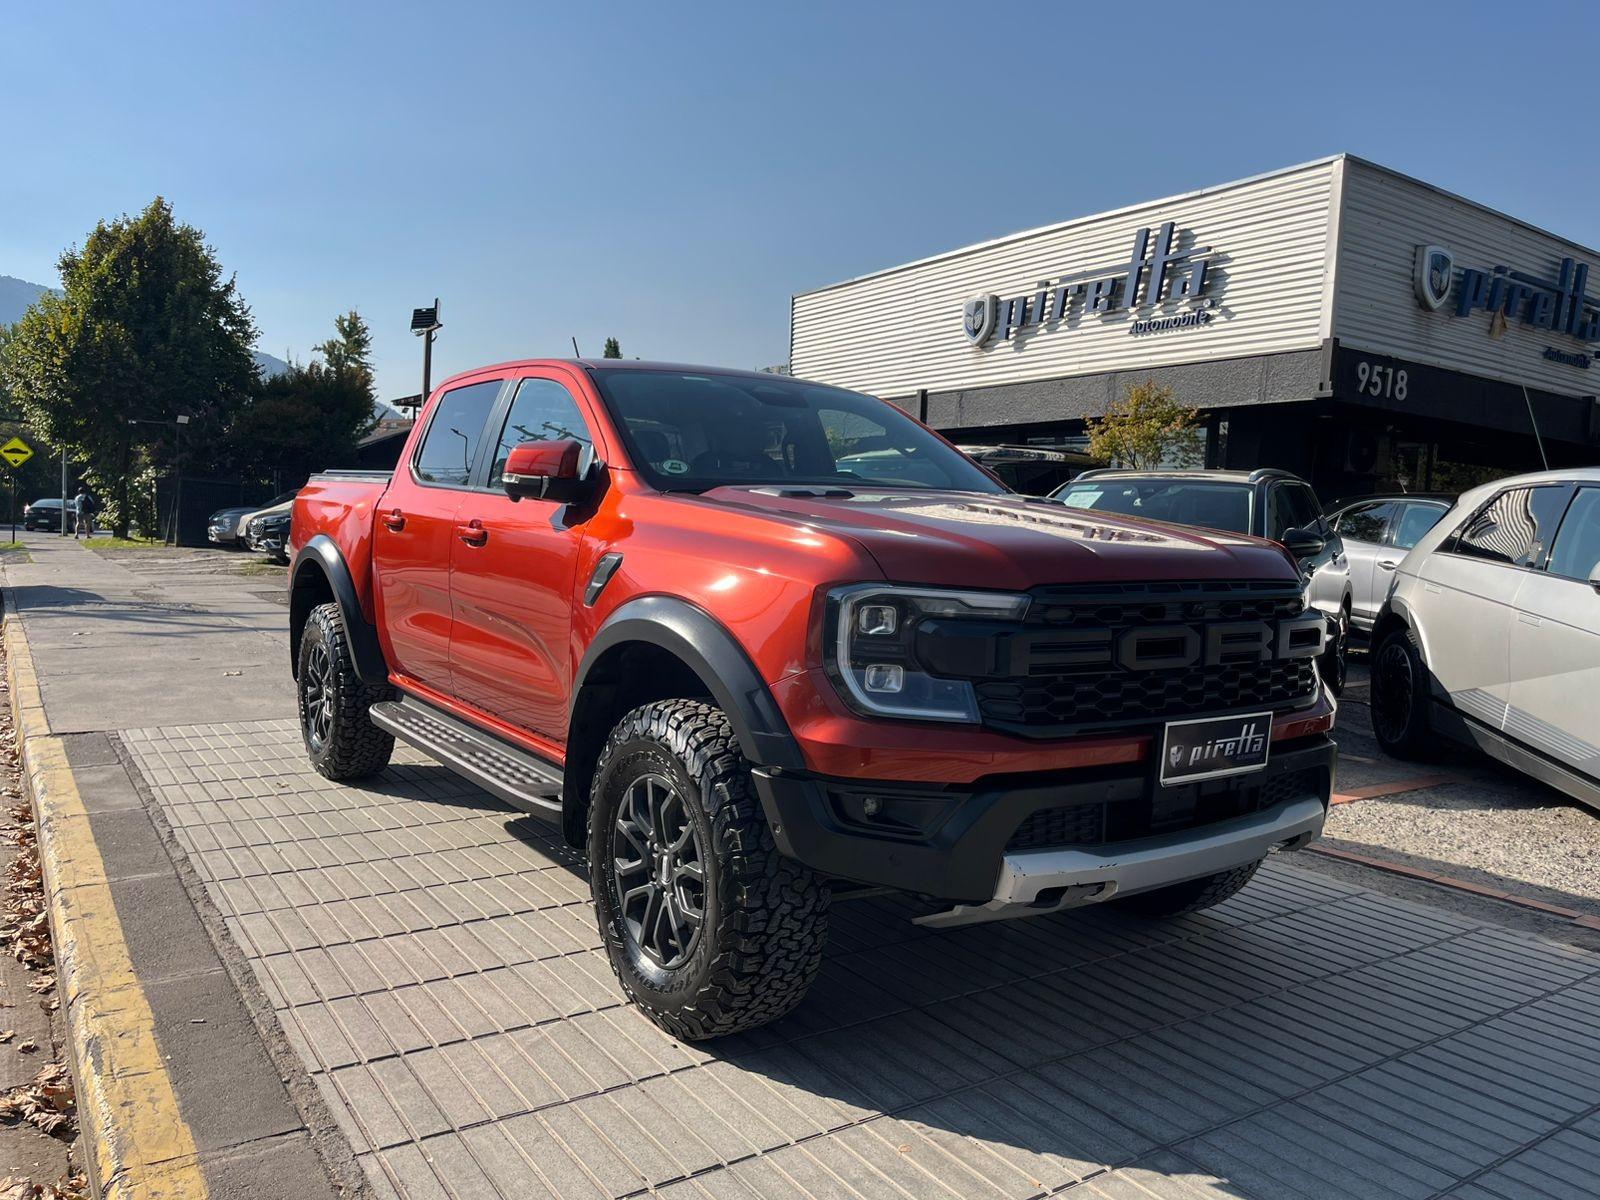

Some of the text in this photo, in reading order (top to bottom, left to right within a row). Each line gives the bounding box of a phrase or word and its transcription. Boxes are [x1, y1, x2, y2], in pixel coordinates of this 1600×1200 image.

[999, 221, 1212, 340] piretta
[1129, 308, 1208, 335] Automobile
[1357, 361, 1408, 401] 9518
[1007, 613, 1328, 677] FORD
[1188, 723, 1265, 767] piretta
